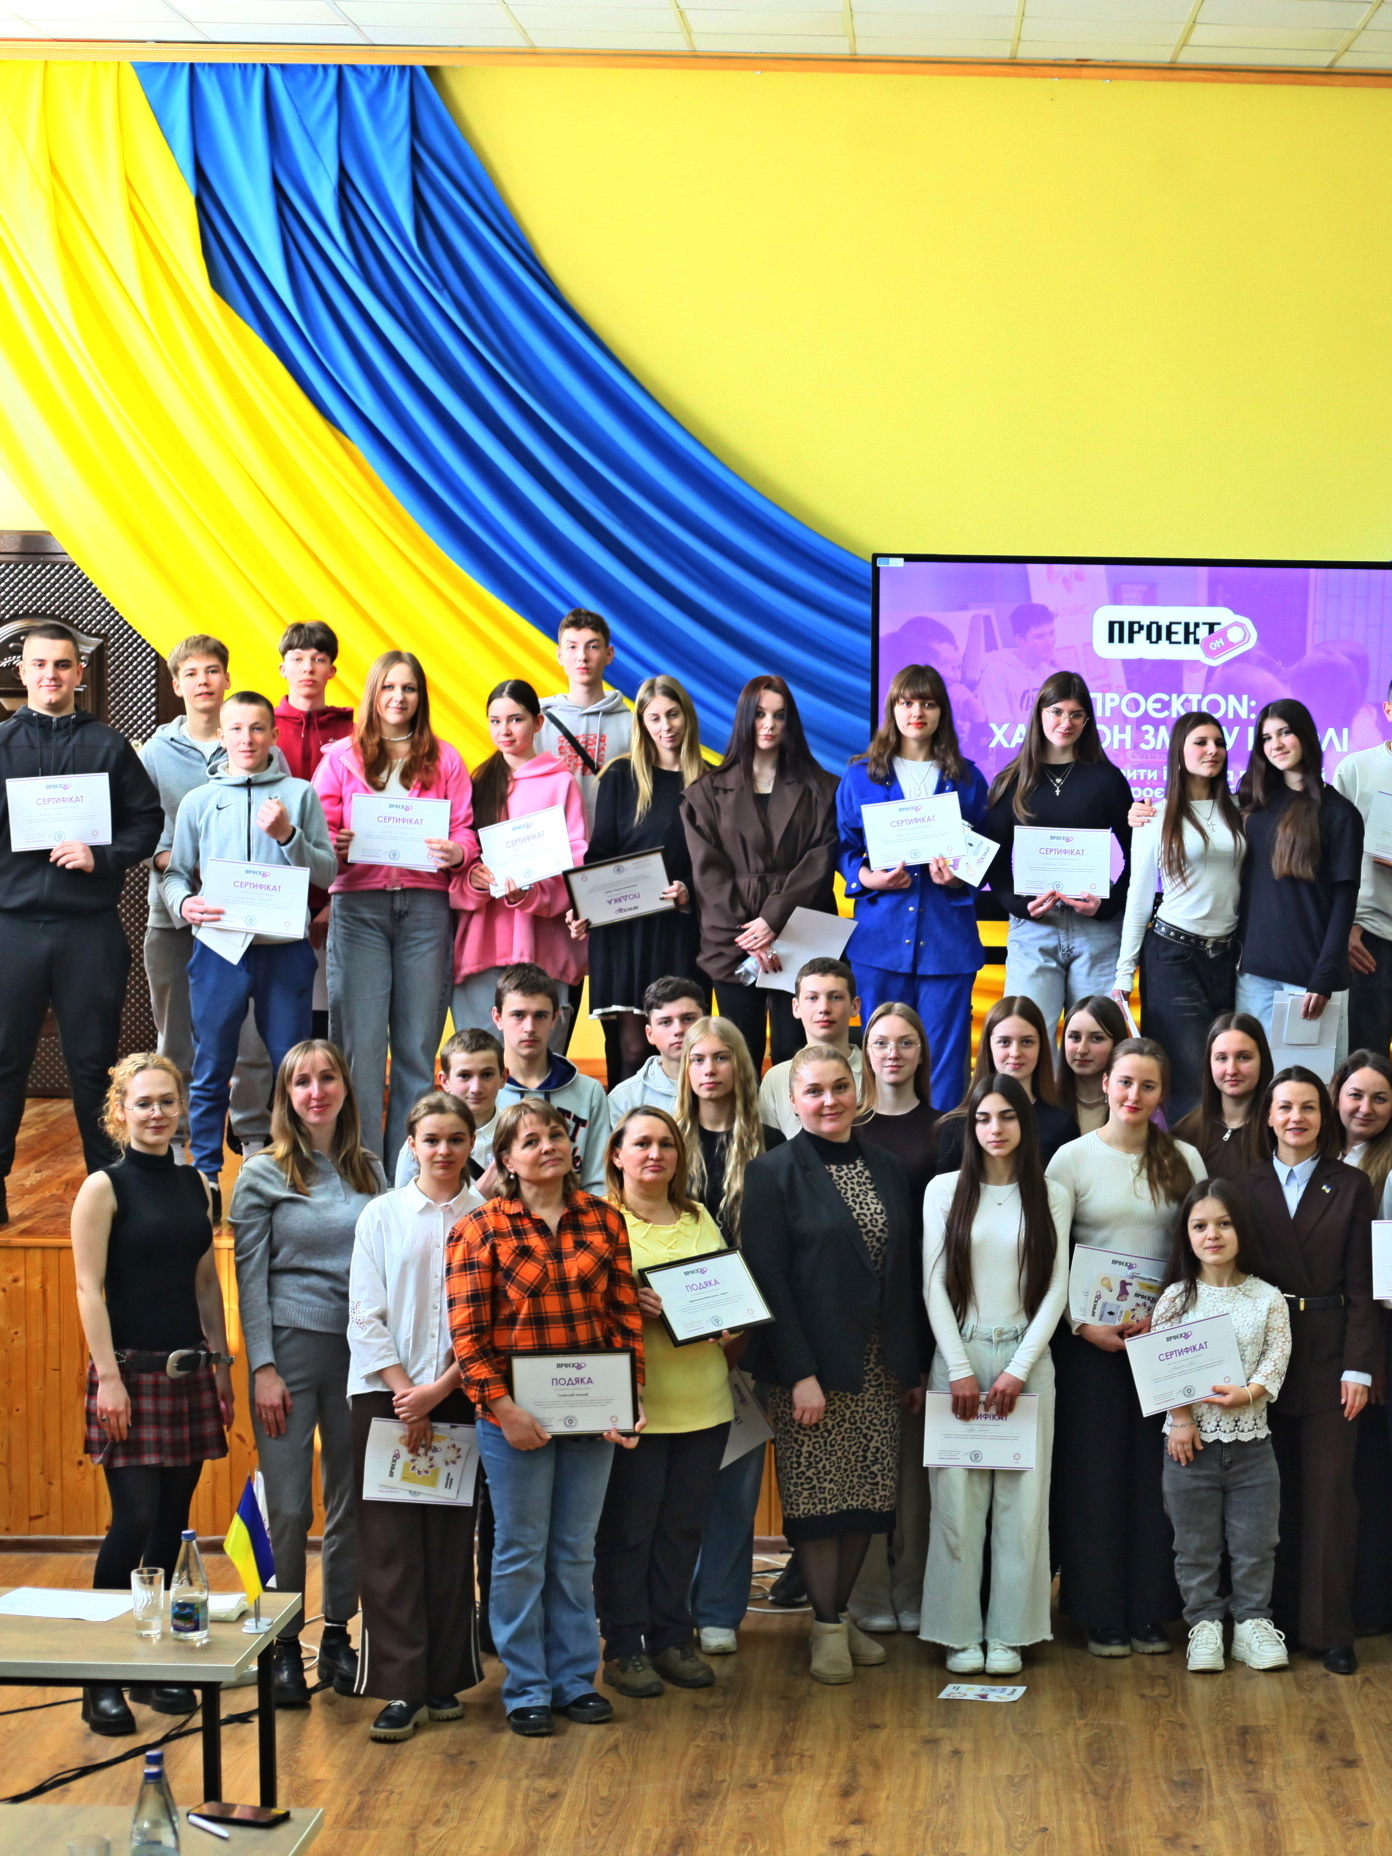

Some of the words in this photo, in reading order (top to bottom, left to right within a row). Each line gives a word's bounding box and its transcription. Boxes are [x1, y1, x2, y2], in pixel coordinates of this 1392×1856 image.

[988, 723, 1131, 749] ХАОН
[36, 795, 84, 806] СЕРТИФІКАТ
[377, 815, 424, 826] СЕРТИФІКАТ
[890, 815, 936, 828] СЕРТИФІКАТ
[1039, 847, 1085, 856] СЕРТИФІКАТ
[233, 880, 282, 892] СЕРТИФІКАТ
[607, 892, 641, 905] ПОДЯКА
[685, 1278, 721, 1293] ПОДЯКА
[1158, 1341, 1209, 1362] СЕРТИФІКАТ
[551, 1376, 593, 1387] ПОДЯКА
